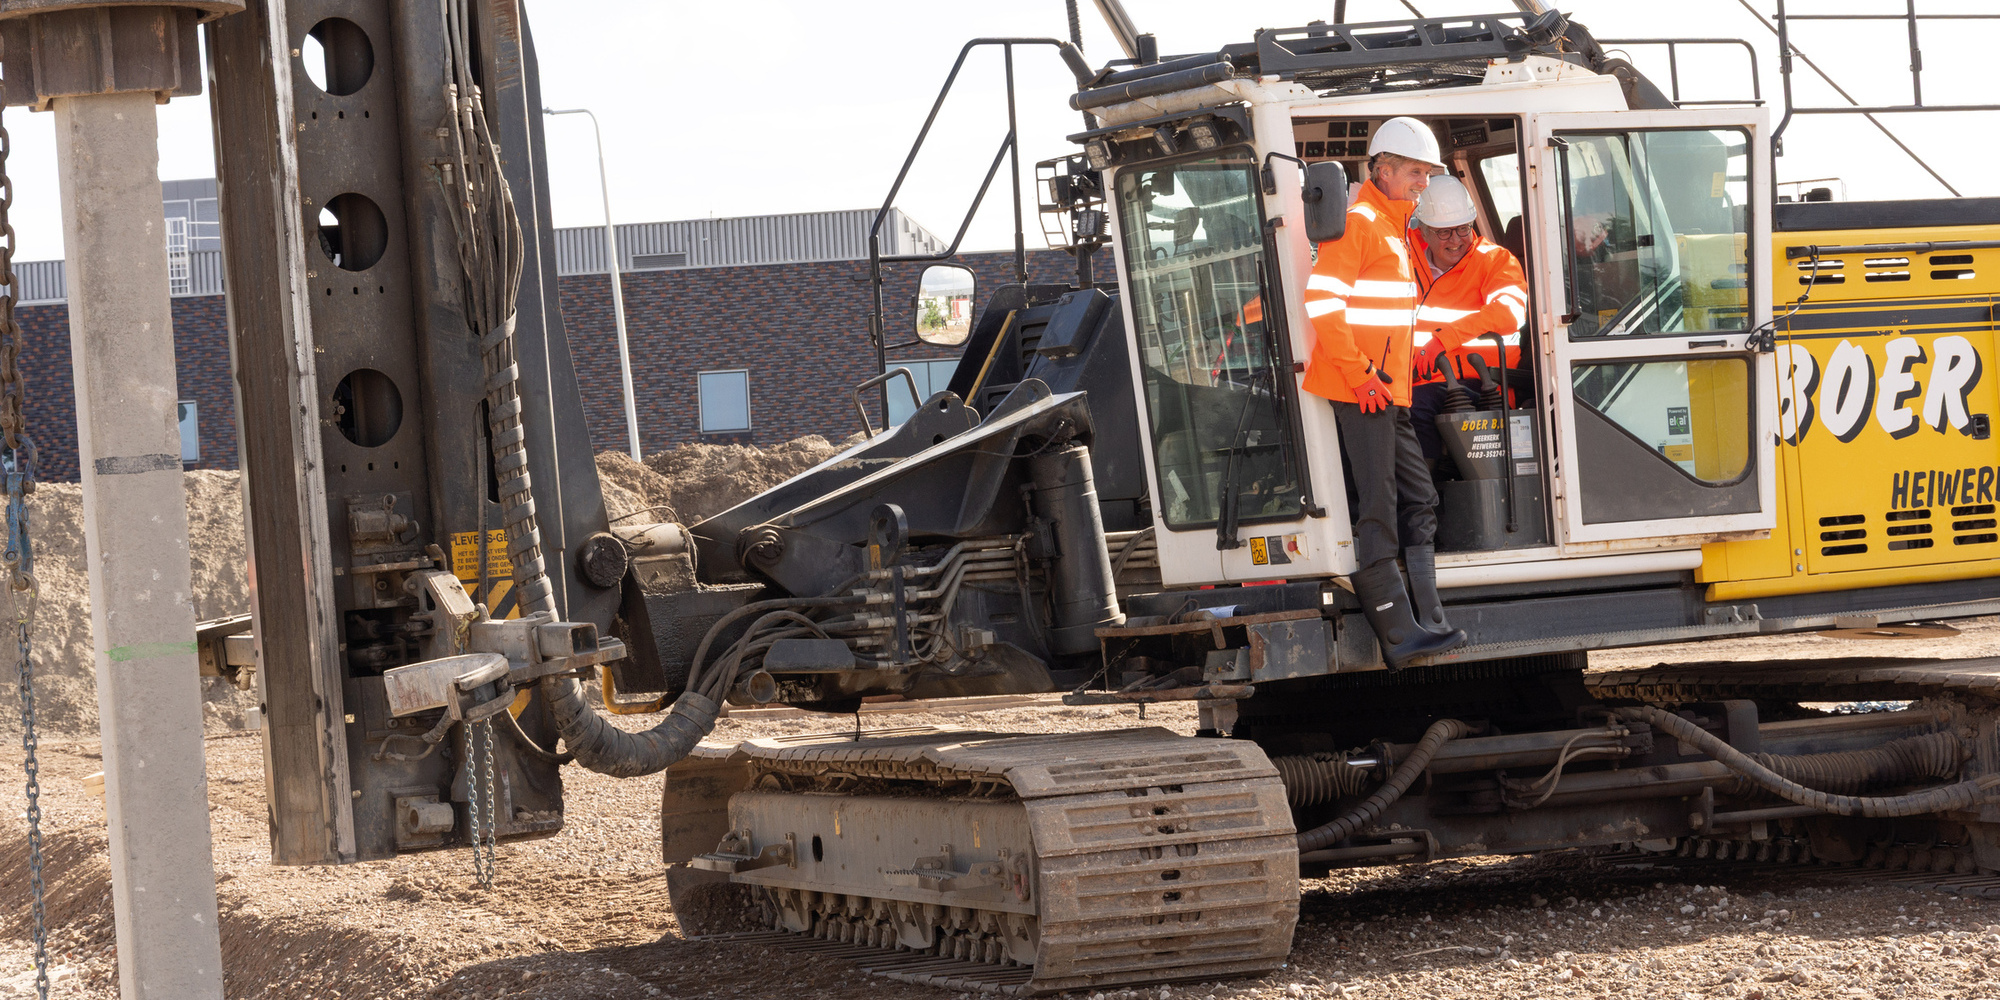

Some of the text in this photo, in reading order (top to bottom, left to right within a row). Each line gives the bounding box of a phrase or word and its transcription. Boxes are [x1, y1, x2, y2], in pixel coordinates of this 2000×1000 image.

[1775, 335, 1979, 443] BOER
[1461, 419, 1488, 431] BOER
[1473, 434, 1499, 442] MEERKERK
[1472, 442, 1501, 450] HEIWERKEN
[1892, 466, 2000, 510] HEIWER
[455, 533, 508, 545] LEVES-GE
